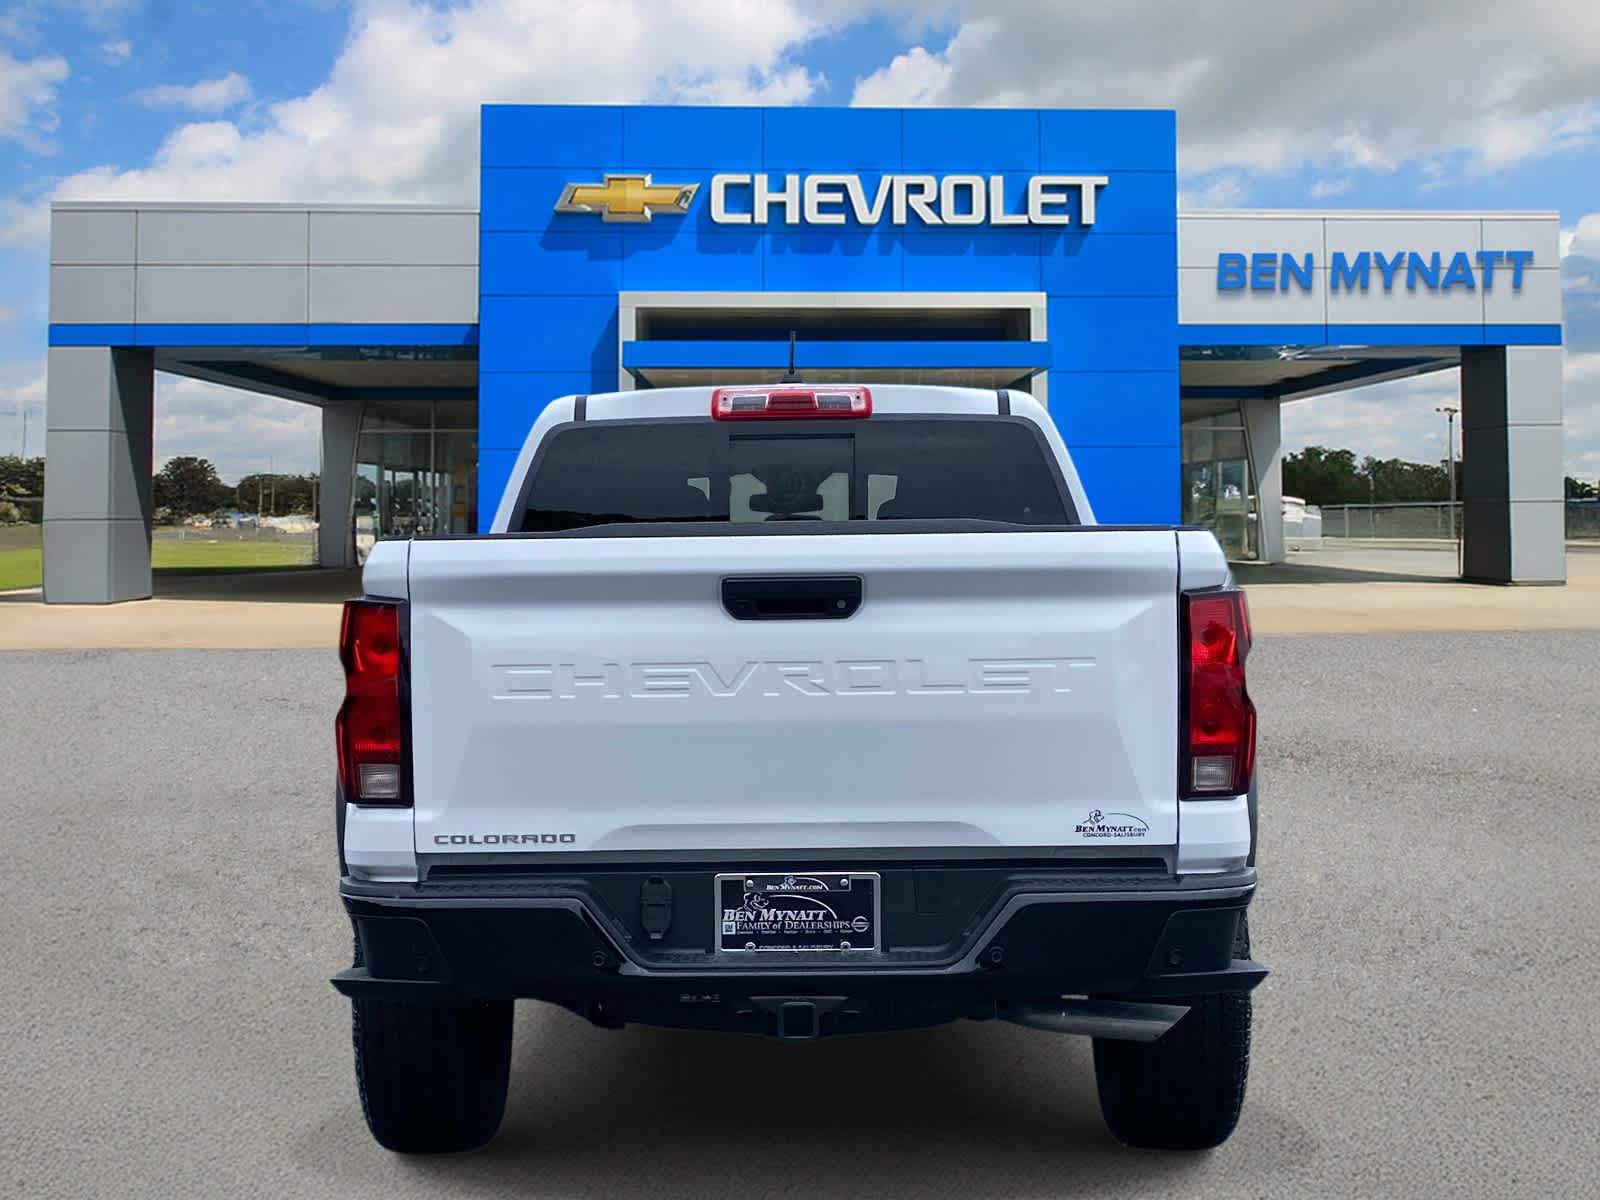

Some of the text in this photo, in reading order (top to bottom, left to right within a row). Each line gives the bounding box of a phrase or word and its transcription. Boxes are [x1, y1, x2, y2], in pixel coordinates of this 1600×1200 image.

[710, 173, 1109, 225] CHEVROLET
[1217, 250, 1534, 290] BEN MYNATT
[491, 656, 1097, 699] CHEVROLET
[1075, 824, 1095, 833] BEN
[434, 833, 576, 845] COLORADO
[723, 909, 827, 921] BEN MYNATT
[737, 921, 770, 930] FAMILY
[784, 920, 851, 930] DEALERSHIPS
